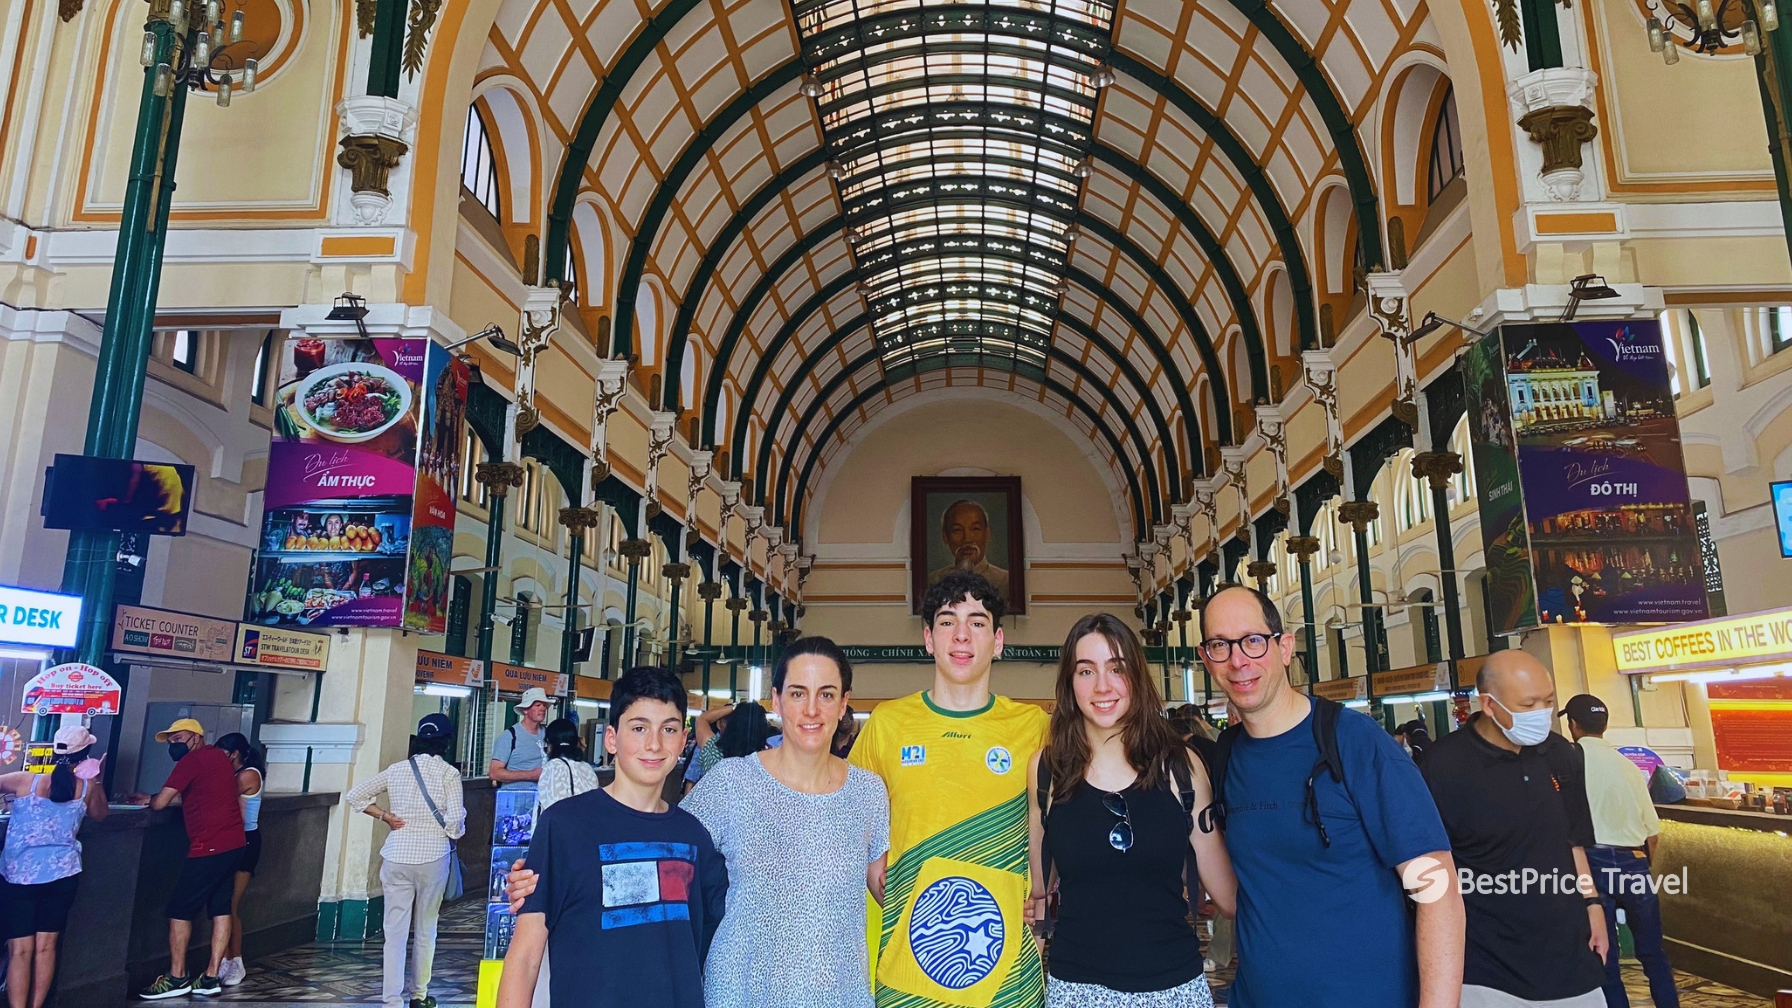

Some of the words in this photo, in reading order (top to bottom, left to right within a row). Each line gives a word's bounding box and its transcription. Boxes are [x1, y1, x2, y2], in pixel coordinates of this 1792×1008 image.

[392, 350, 423, 366] Vietnam
[1606, 338, 1659, 362] Vietnam
[304, 453, 327, 473] Du
[1564, 462, 1587, 482] Du
[317, 471, 338, 487] ẨM
[341, 474, 375, 489] THỰC
[1590, 481, 1612, 496] ĐÔ
[1614, 483, 1638, 497] THỊ
[13, 605, 63, 629] DESK
[1613, 607, 1702, 615] www.vietnamtourism.gov.vn
[126, 615, 156, 631] TICKET
[158, 621, 199, 636] COUNTER
[843, 647, 870, 657] HÓNG
[881, 647, 913, 657] CHÍNH
[1016, 647, 1041, 657] TOÀN
[1622, 640, 1652, 662] BEST
[1655, 631, 1716, 659] COFFEES
[1717, 629, 1733, 651] IN
[1734, 624, 1767, 648] THE
[417, 654, 429, 666] ƯU
[432, 657, 453, 672] NIỆM
[37, 670, 57, 684] Hop
[80, 665, 99, 676] Hop
[100, 675, 113, 687] off
[1250, 803, 1257, 811] &
[1260, 801, 1278, 810] Fitch
